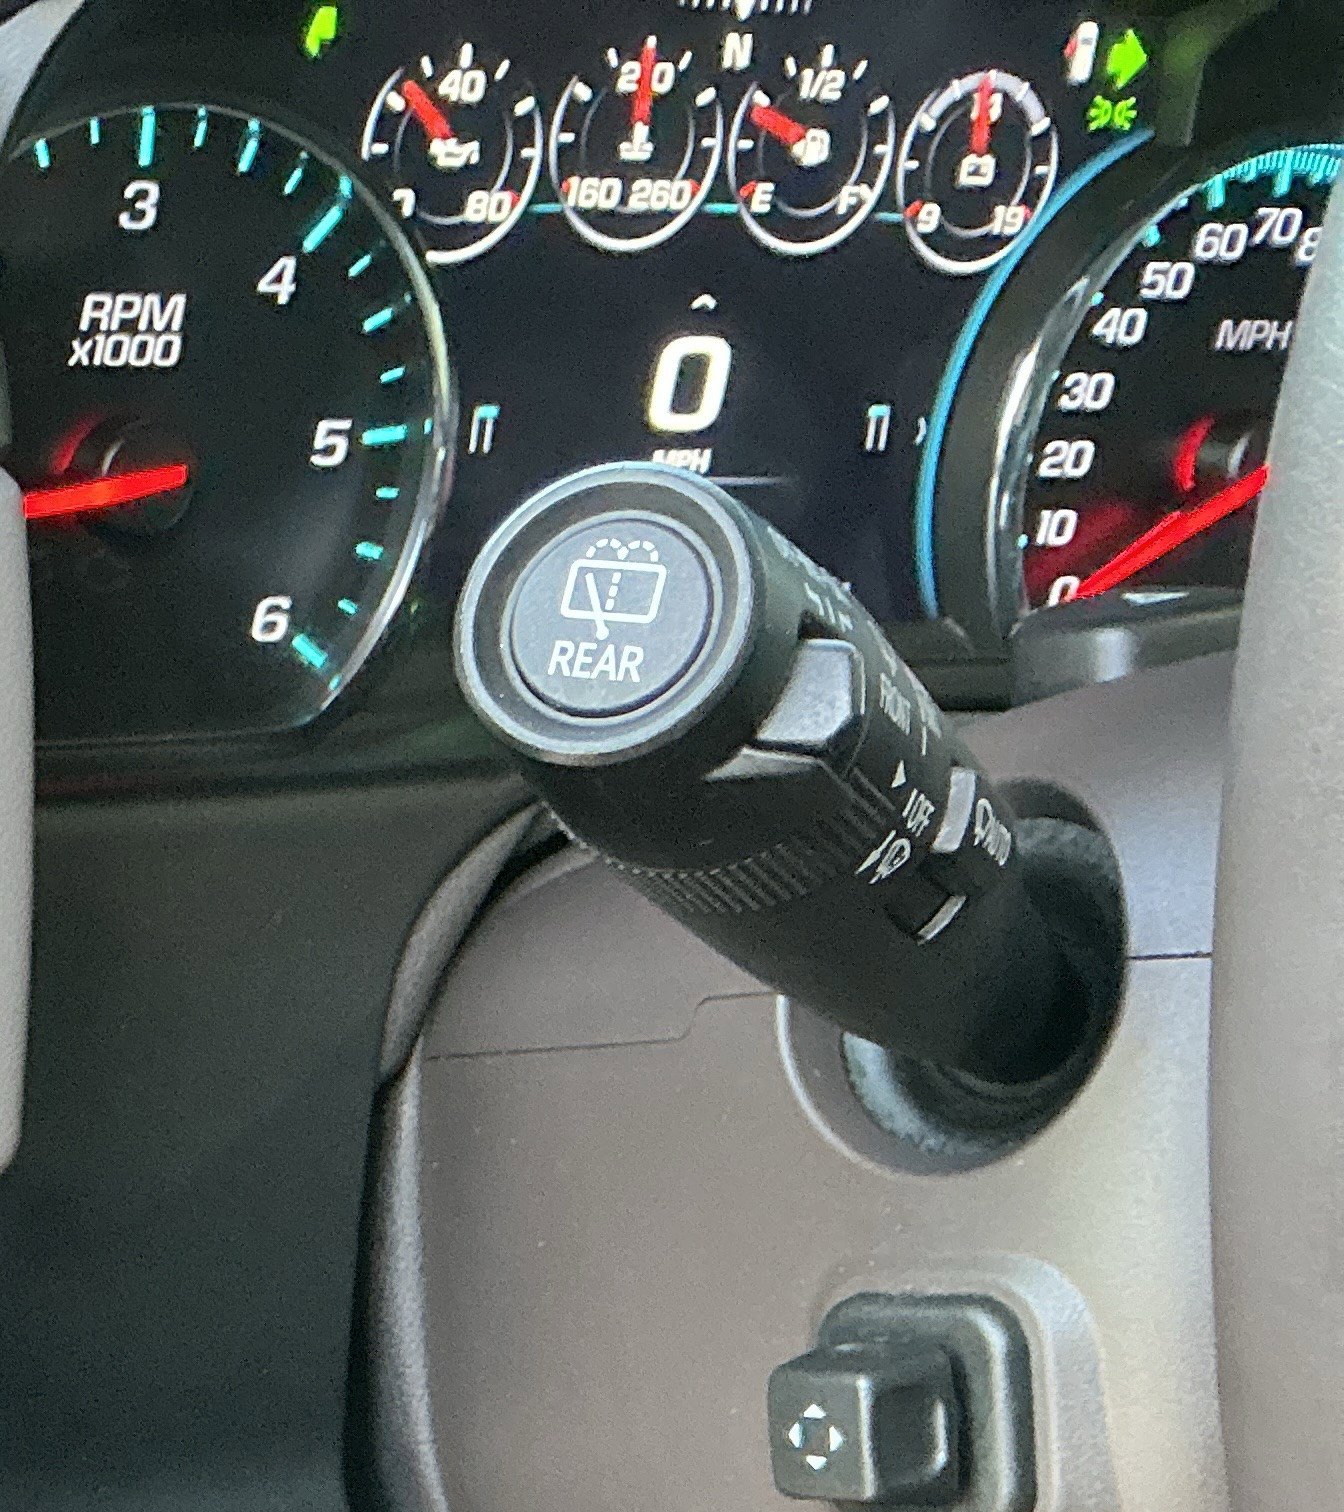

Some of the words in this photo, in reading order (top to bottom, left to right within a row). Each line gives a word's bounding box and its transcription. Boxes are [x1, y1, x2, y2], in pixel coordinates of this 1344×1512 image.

[722, 31, 753, 71] N
[438, 69, 487, 103] 40
[616, 61, 676, 95] 20
[798, 68, 846, 102] 1/2
[118, 180, 160, 231] 3
[465, 190, 512, 223] 80
[567, 177, 623, 209] 160
[628, 178, 693, 211] 260
[750, 182, 776, 213] E
[917, 203, 942, 234] 9
[992, 204, 1025, 236] 19
[1250, 207, 1303, 246] 70
[1193, 222, 1248, 263] 60
[1297, 226, 1322, 262] 8
[256, 255, 297, 305] 4
[1139, 261, 1194, 300] 50
[80, 293, 187, 333] RPM
[1092, 307, 1148, 347] 40
[67, 333, 183, 368] x1000
[1215, 319, 1294, 352] MPH
[649, 335, 732, 434] 0
[1058, 372, 1115, 411] 30
[310, 418, 353, 467] 5
[1036, 440, 1095, 479] 20
[1035, 509, 1078, 548] 10
[1048, 575, 1080, 607] 0
[250, 595, 293, 644] 6
[547, 639, 644, 684] REAR
